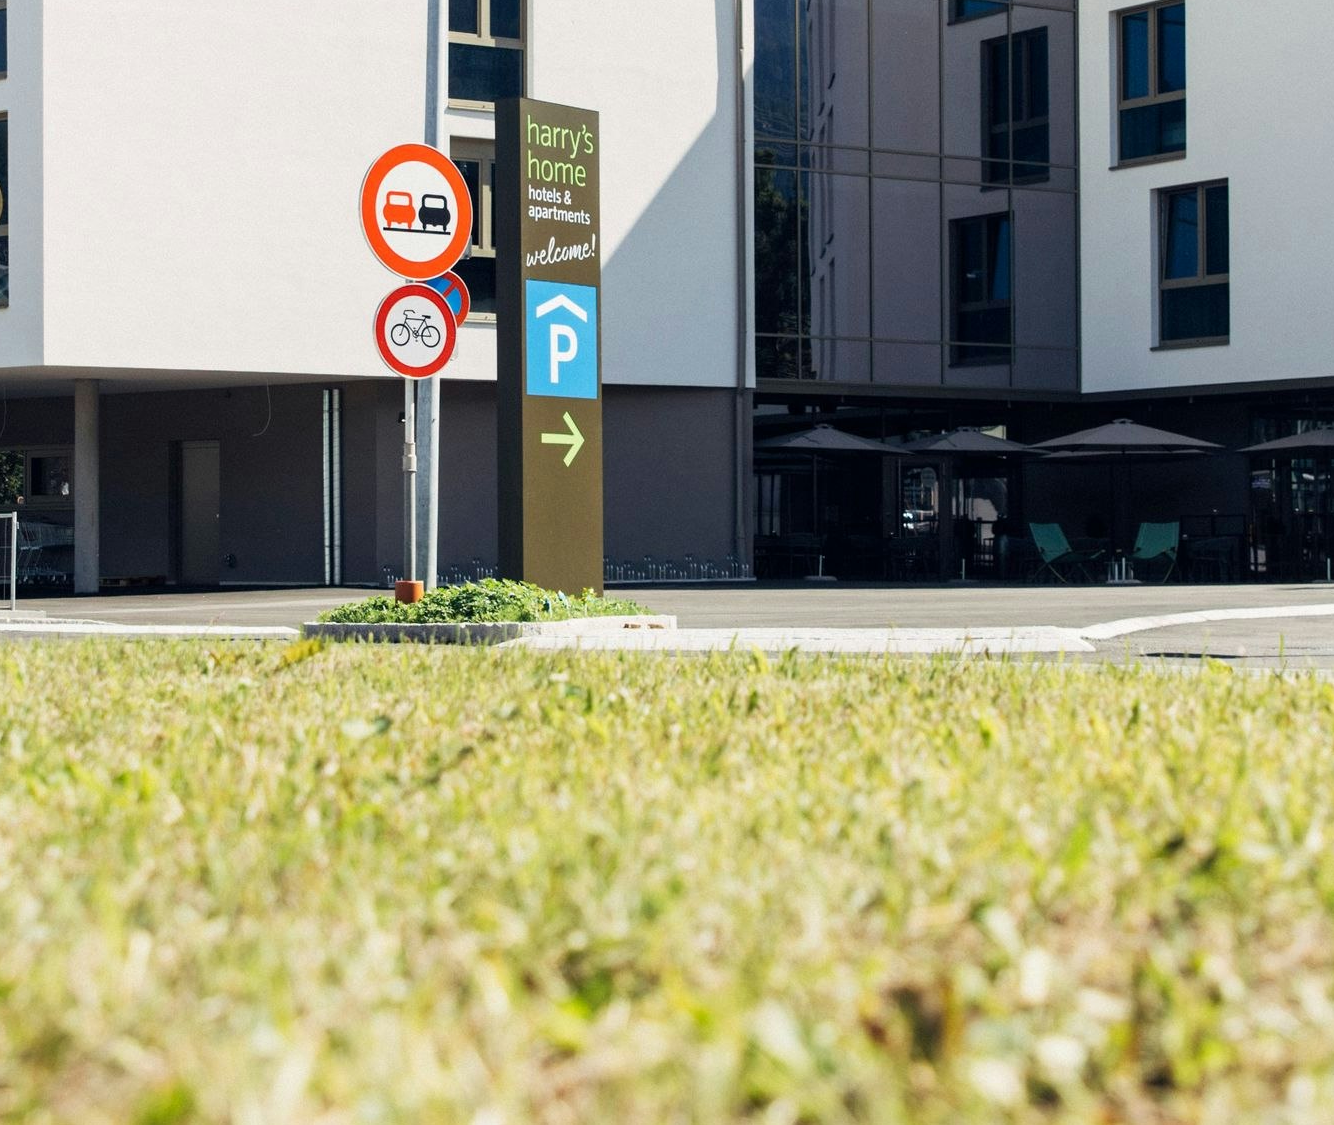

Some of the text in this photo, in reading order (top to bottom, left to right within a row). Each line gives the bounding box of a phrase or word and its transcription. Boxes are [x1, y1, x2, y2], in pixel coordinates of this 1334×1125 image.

[527, 114, 594, 159] harry's
[527, 149, 586, 187] home
[528, 184, 572, 205] hotels &
[528, 205, 591, 225] apartments
[526, 233, 596, 267] welcome!
[549, 324, 578, 384] P
